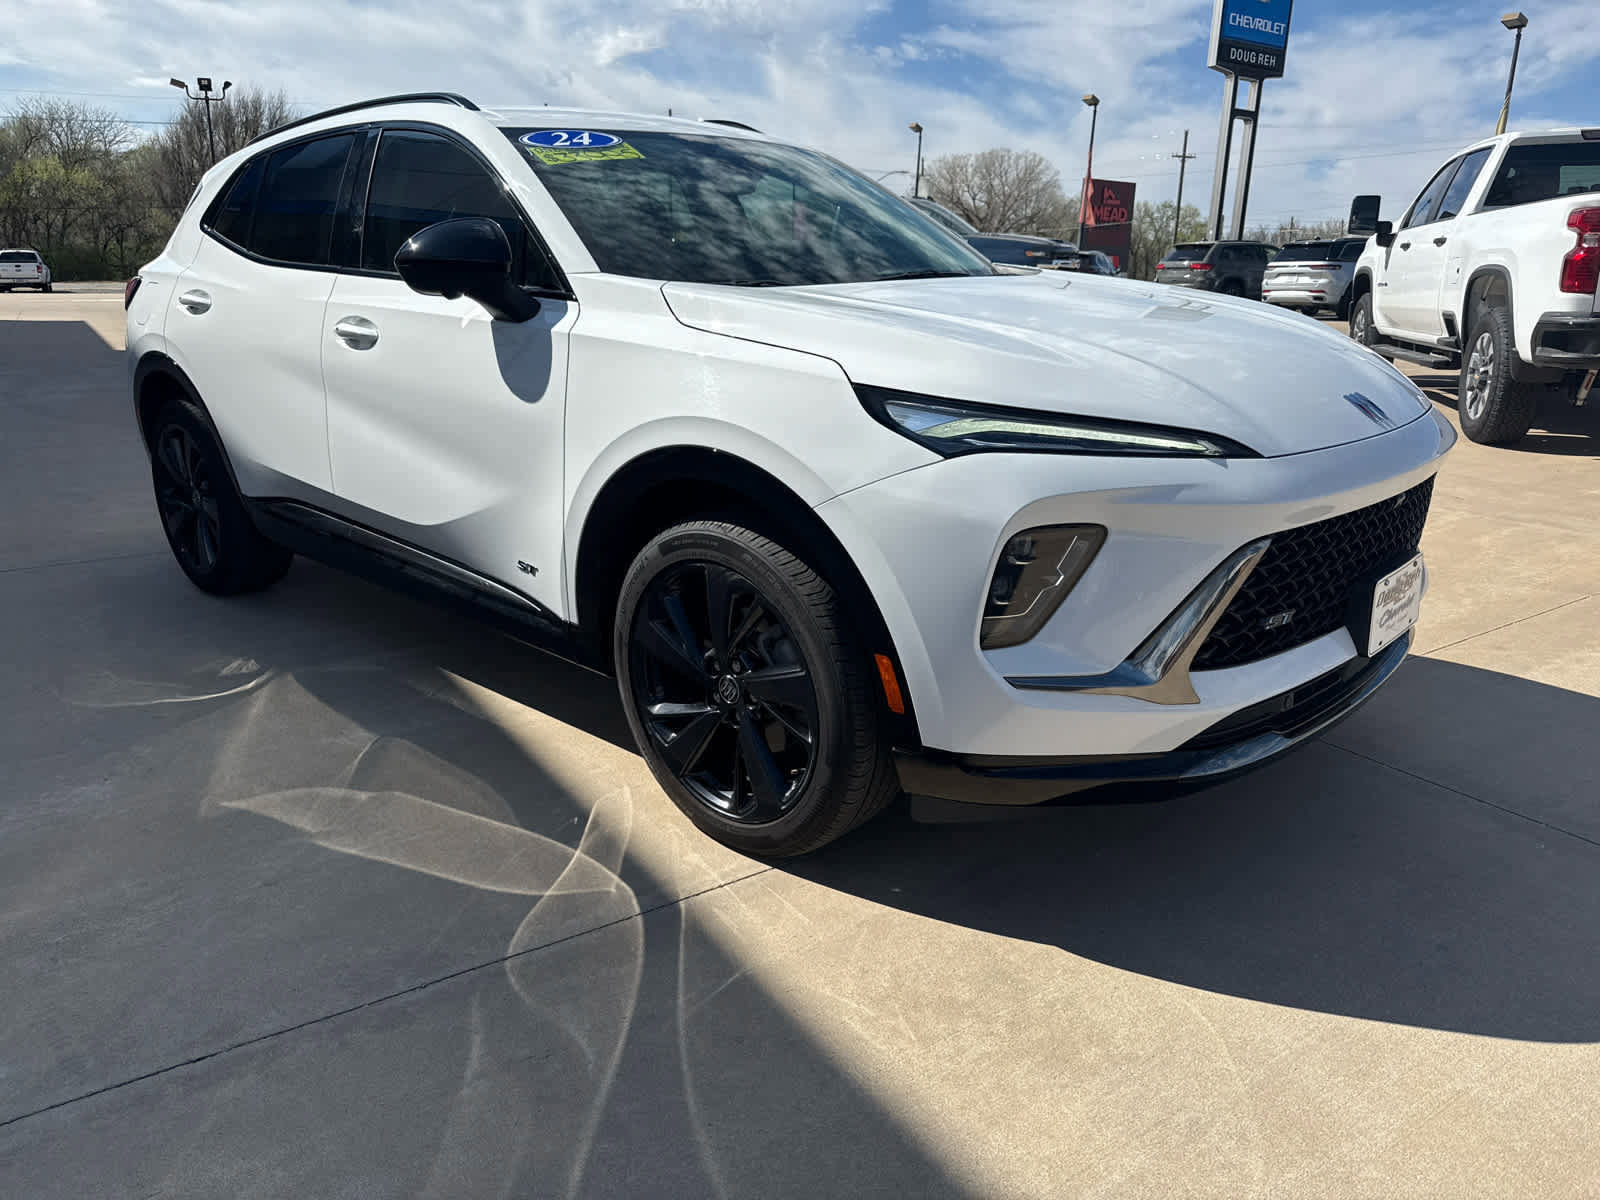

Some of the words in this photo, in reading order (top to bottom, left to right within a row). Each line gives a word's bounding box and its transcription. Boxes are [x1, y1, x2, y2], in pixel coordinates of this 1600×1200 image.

[1229, 12, 1286, 36] CHEVROLET
[1230, 47, 1256, 63] DOUG
[1257, 53, 1276, 67] REH
[551, 131, 593, 146] 24
